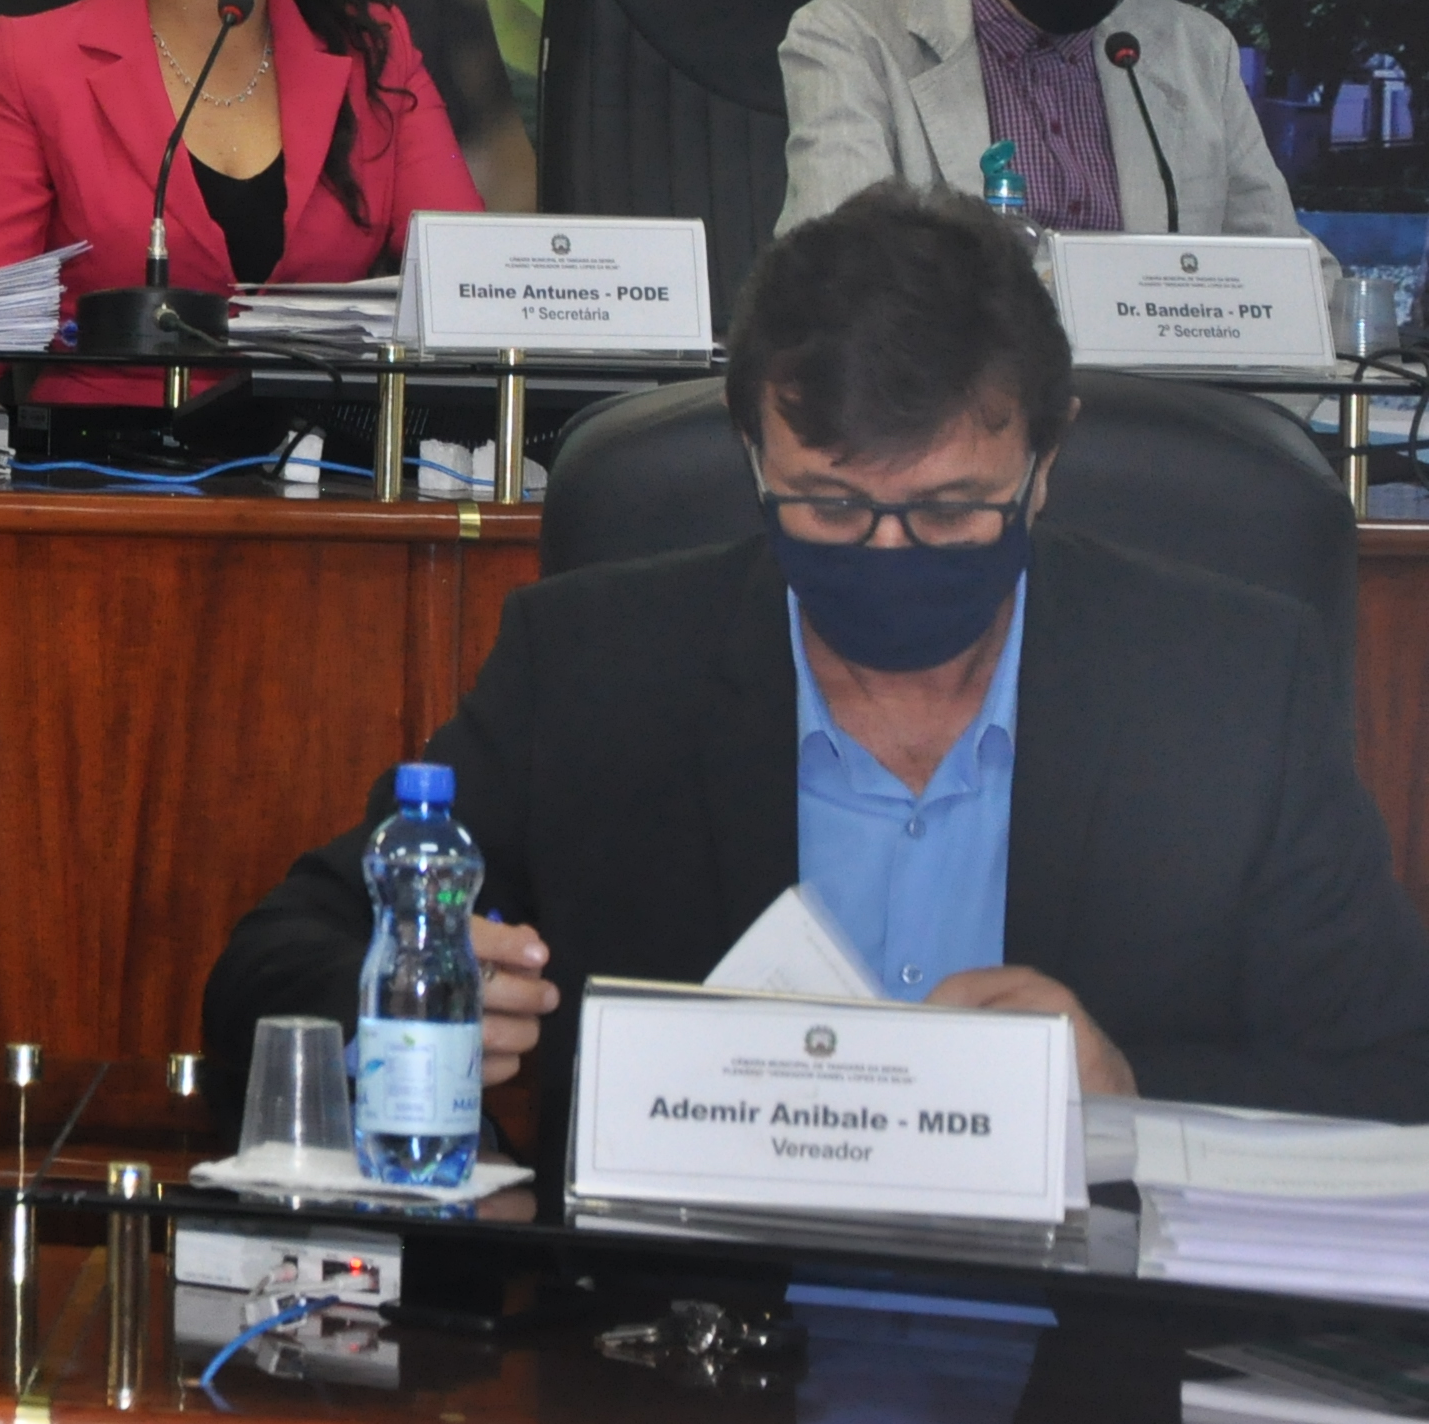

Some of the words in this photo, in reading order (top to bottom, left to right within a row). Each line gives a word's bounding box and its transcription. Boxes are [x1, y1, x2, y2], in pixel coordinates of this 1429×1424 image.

[459, 283, 516, 300] Elaine
[523, 285, 600, 301] Antunes
[617, 286, 670, 302] PODE
[538, 307, 610, 321] Secretária
[1117, 302, 1141, 317] Dr.
[1146, 303, 1223, 319] Bandeira
[1239, 305, 1273, 320] PDT
[1174, 324, 1241, 338] Secretário
[649, 1096, 761, 1124] Ademir
[770, 1102, 889, 1132] Anibale
[918, 1110, 991, 1136] MDB
[772, 1137, 874, 1162] Vereador
